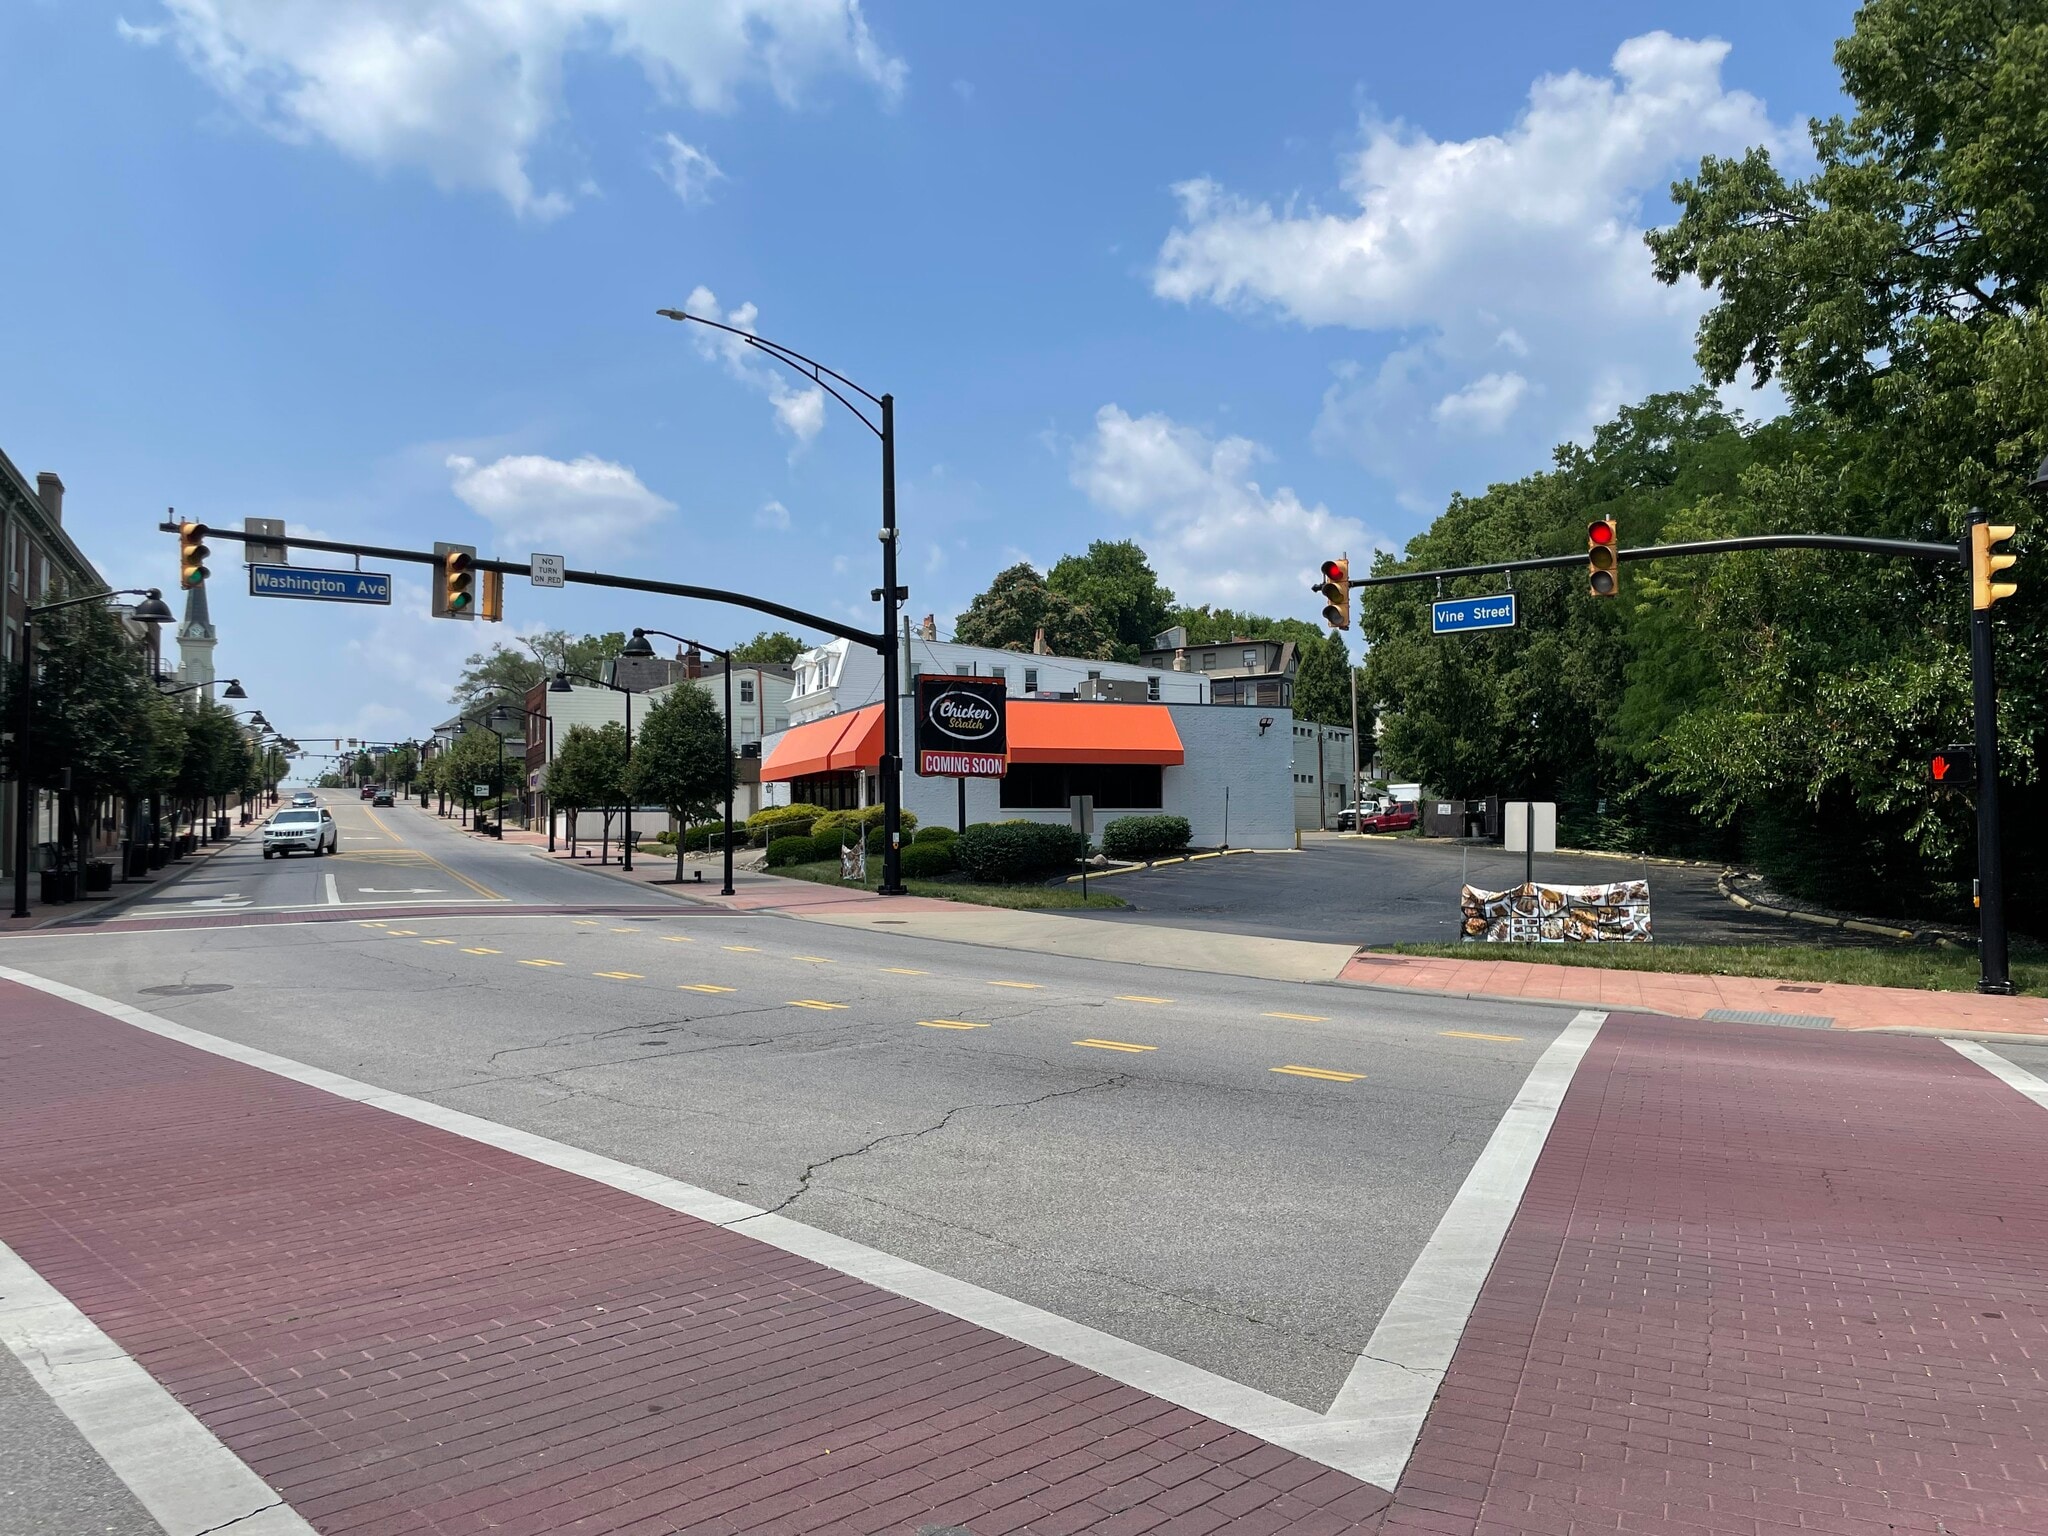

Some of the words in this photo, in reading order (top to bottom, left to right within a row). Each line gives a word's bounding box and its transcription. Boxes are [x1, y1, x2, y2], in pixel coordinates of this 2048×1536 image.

[542, 558, 553, 566] NO
[539, 566, 558, 575] TURN
[256, 573, 346, 594] Washington
[357, 581, 387, 596] Ave
[547, 576, 561, 584] RED
[1437, 611, 1464, 623] Vine
[1473, 604, 1511, 620] Street
[940, 701, 992, 720] Chicken
[948, 717, 985, 730] Scratch
[925, 755, 970, 773] COMING
[972, 758, 1002, 774] SOON
